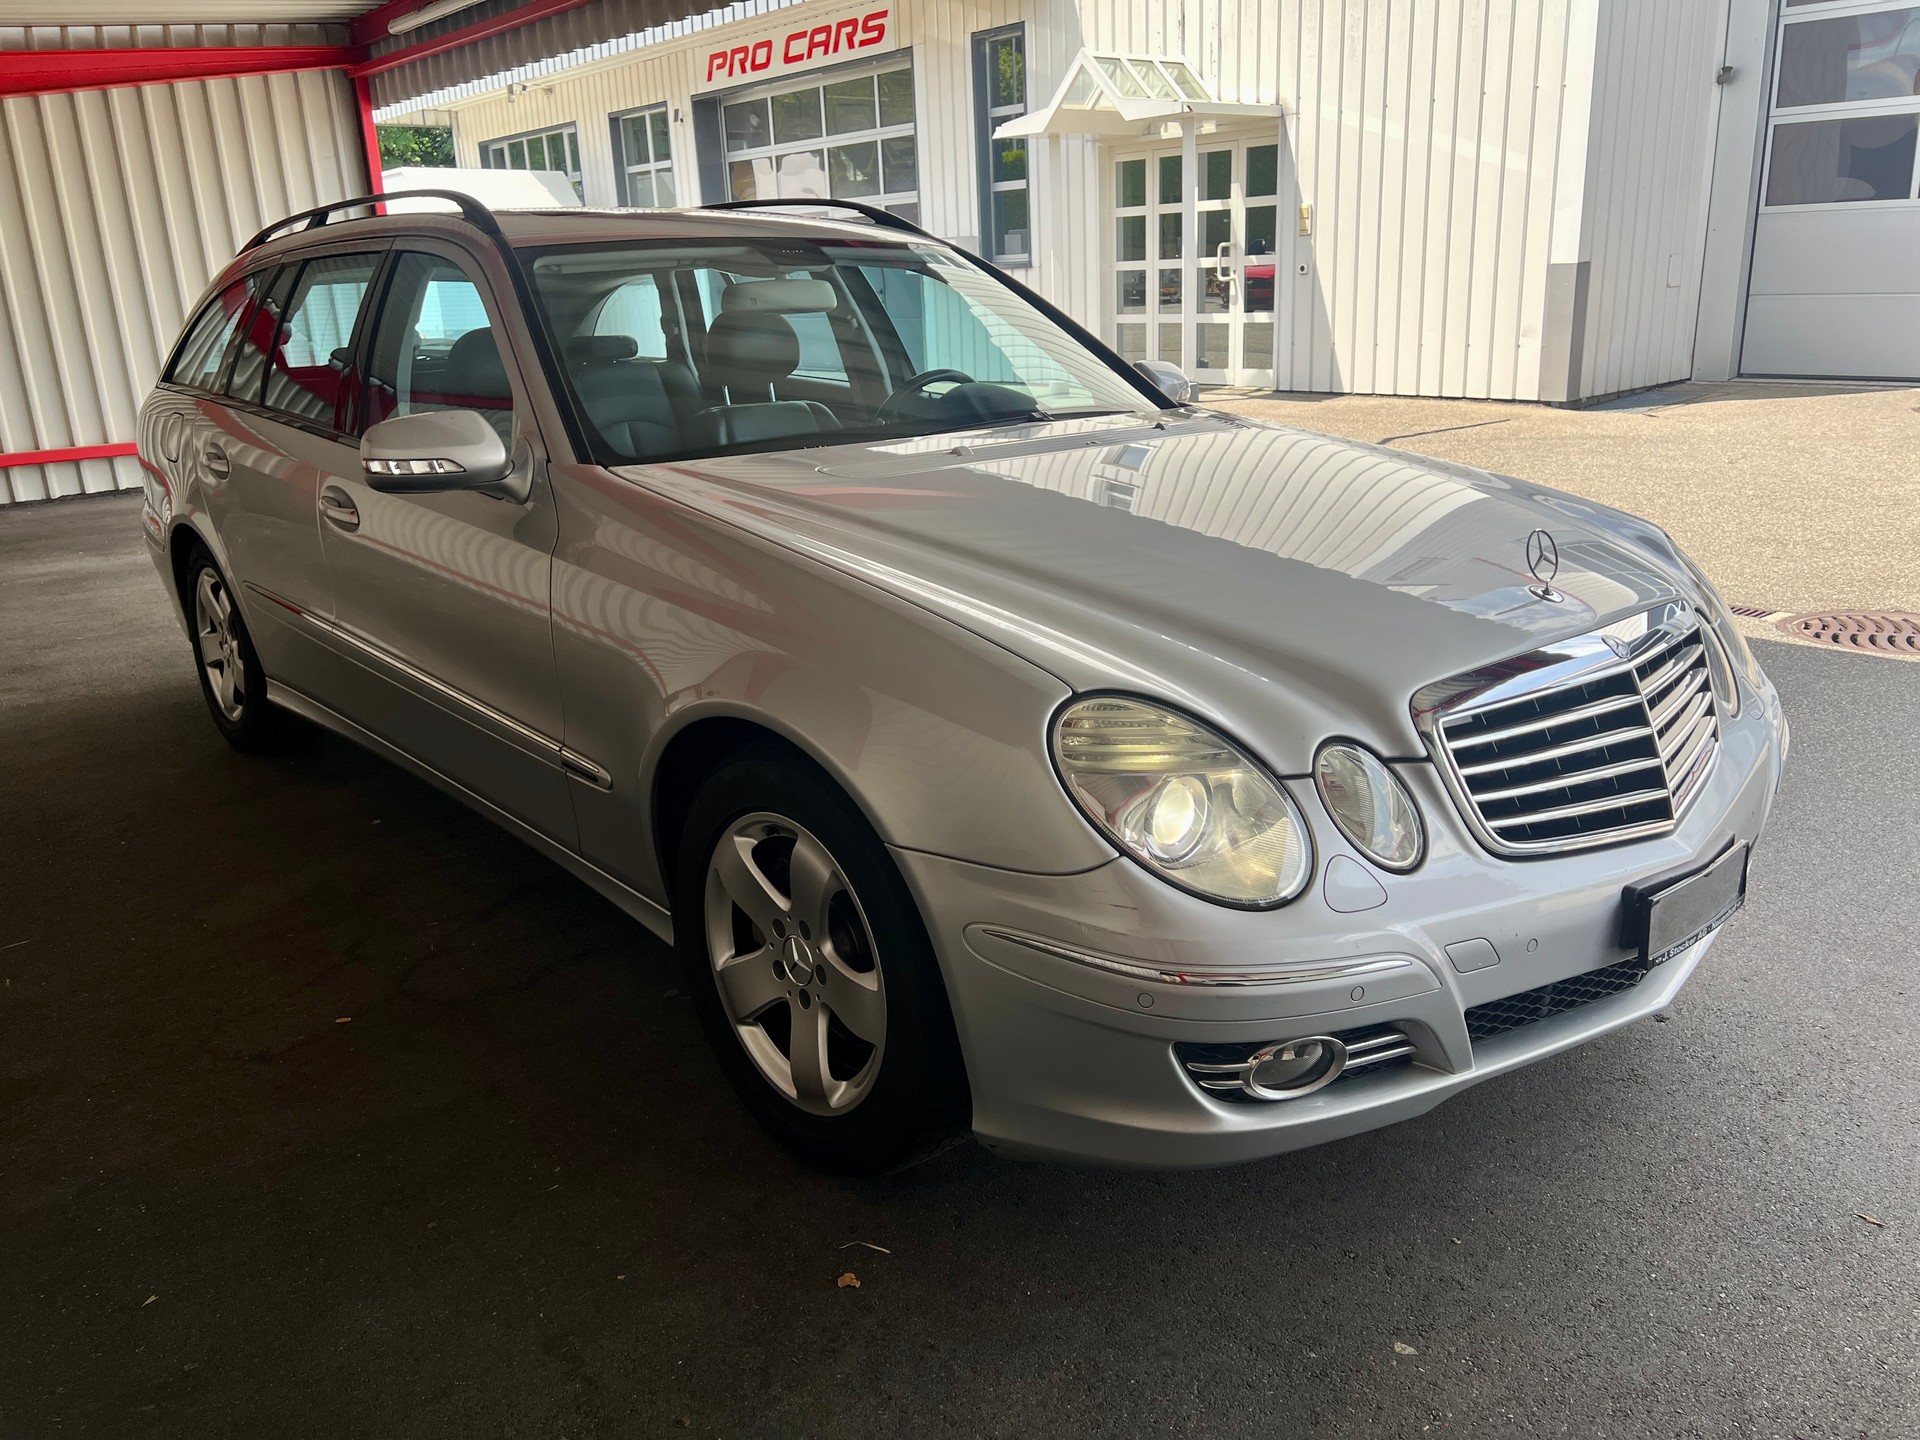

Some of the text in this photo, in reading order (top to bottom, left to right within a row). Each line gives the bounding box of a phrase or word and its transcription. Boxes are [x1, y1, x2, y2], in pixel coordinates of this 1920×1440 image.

[707, 9, 889, 82] PRO CARS
[1669, 936, 1697, 957] Stocker
[1697, 928, 1708, 940] AG
